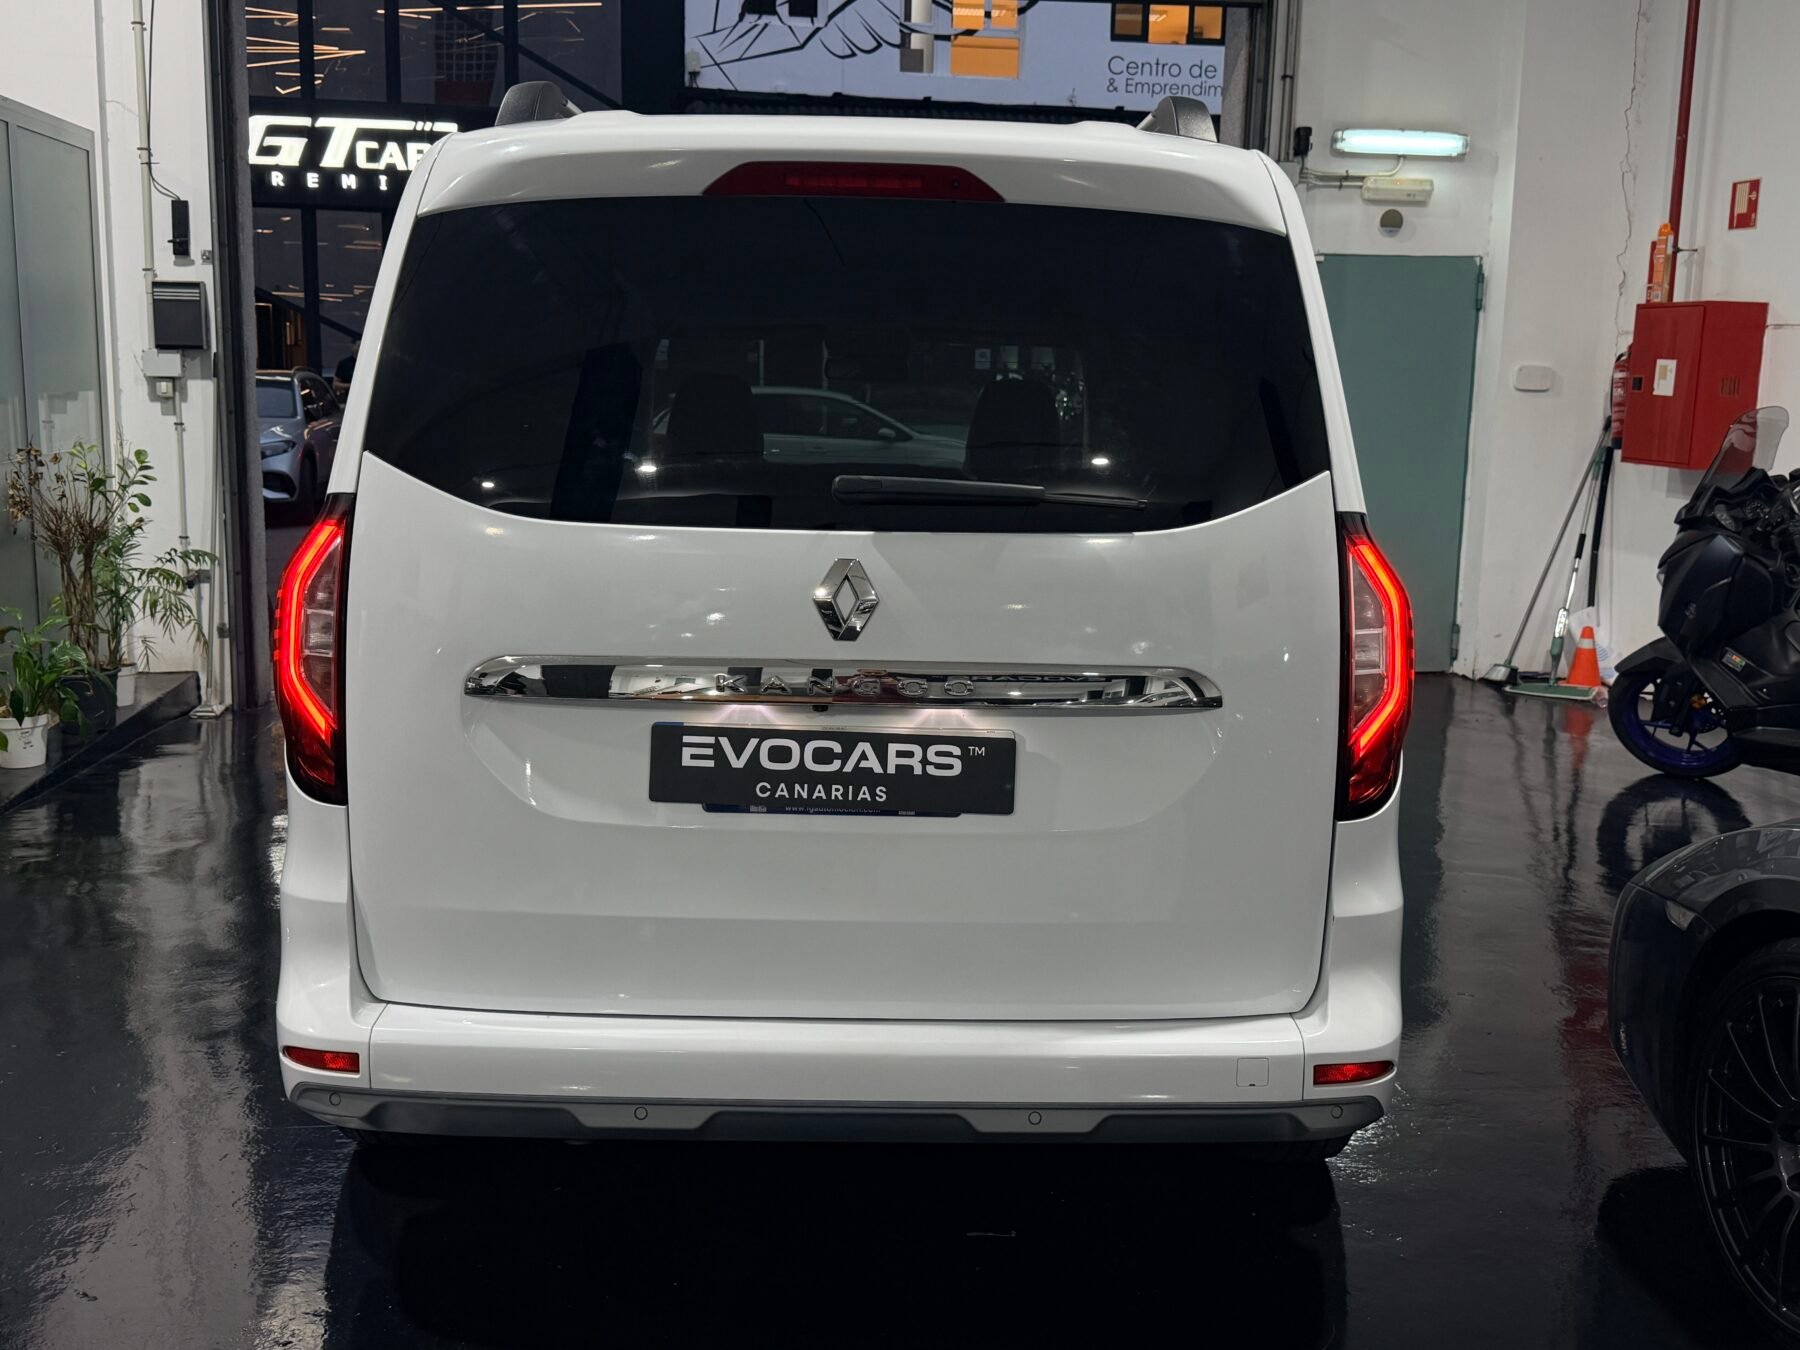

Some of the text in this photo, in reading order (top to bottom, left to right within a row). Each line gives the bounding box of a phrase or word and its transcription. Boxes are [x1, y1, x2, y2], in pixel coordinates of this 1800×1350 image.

[1107, 55, 1217, 79] Centro de
[1106, 77, 1119, 93] &
[715, 673, 975, 697] KANGOO
[681, 735, 962, 777] EVOCARS
[755, 781, 888, 802] CANARIAS
